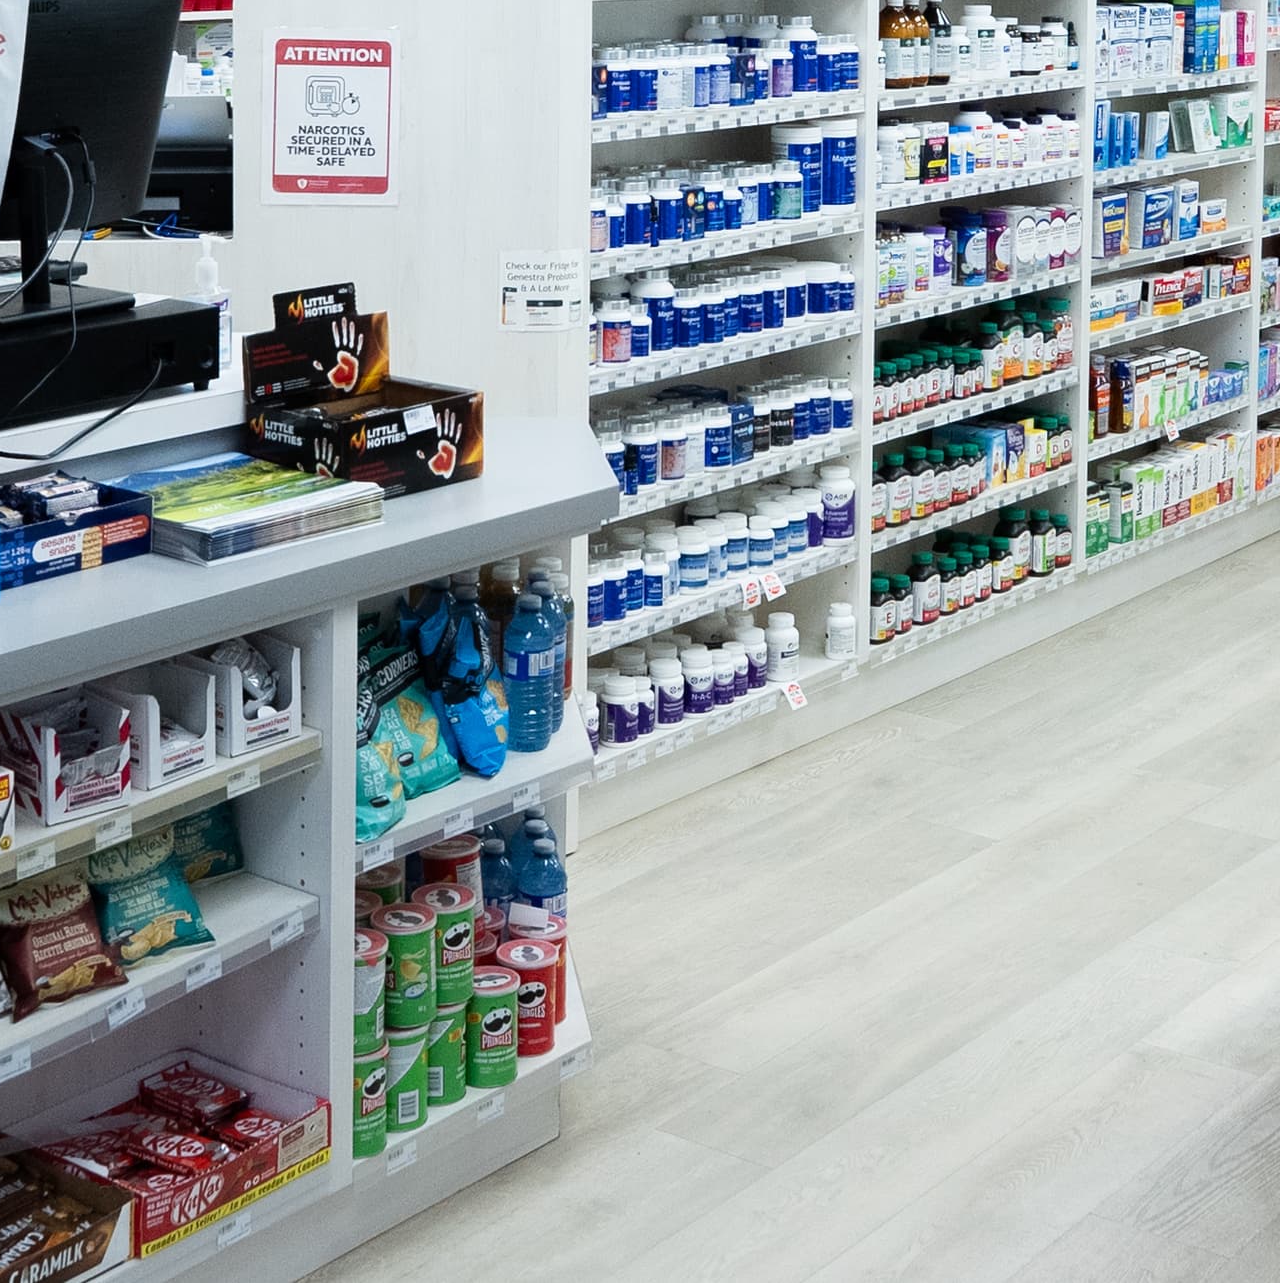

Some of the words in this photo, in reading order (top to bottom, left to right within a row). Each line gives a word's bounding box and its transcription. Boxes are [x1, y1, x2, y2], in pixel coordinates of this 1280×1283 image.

[284, 47, 383, 62] ATTENTION
[298, 125, 365, 136] NARCOTICS
[291, 136, 346, 146] SECURED
[349, 137, 361, 146] IN
[364, 137, 372, 146] A
[287, 146, 376, 157] TIME-DELAYED
[316, 157, 346, 167] SAFE
[505, 261, 530, 270] Check
[507, 273, 544, 281] Genestra
[1154, 281, 1183, 296] TYLENOL
[304, 294, 335, 308] LITTLE
[305, 302, 344, 317] HOTTIES
[265, 420, 295, 434] LITTLE
[367, 423, 399, 438] LITTLE
[265, 430, 303, 447] HOTTIES
[367, 432, 407, 449] HOTTIES
[833, 492, 848, 502] AOR
[40, 533, 76, 550] sesame
[49, 544, 76, 557] snaps
[691, 691, 712, 702] N-A-C
[32, 928, 65, 947] ORIGINAL
[65, 922, 89, 940] RECIPE
[32, 946, 65, 964] RECETTE
[442, 947, 472, 965] PRINGLES
[481, 1028, 514, 1048] PRINGLES
[142, 1134, 205, 1158] KitKat
[172, 1173, 222, 1225] KitKat
[145, 1229, 181, 1255] Canada's
[258, 1180, 285, 1198] vendue
[8, 1239, 86, 1283] CARAMILK
